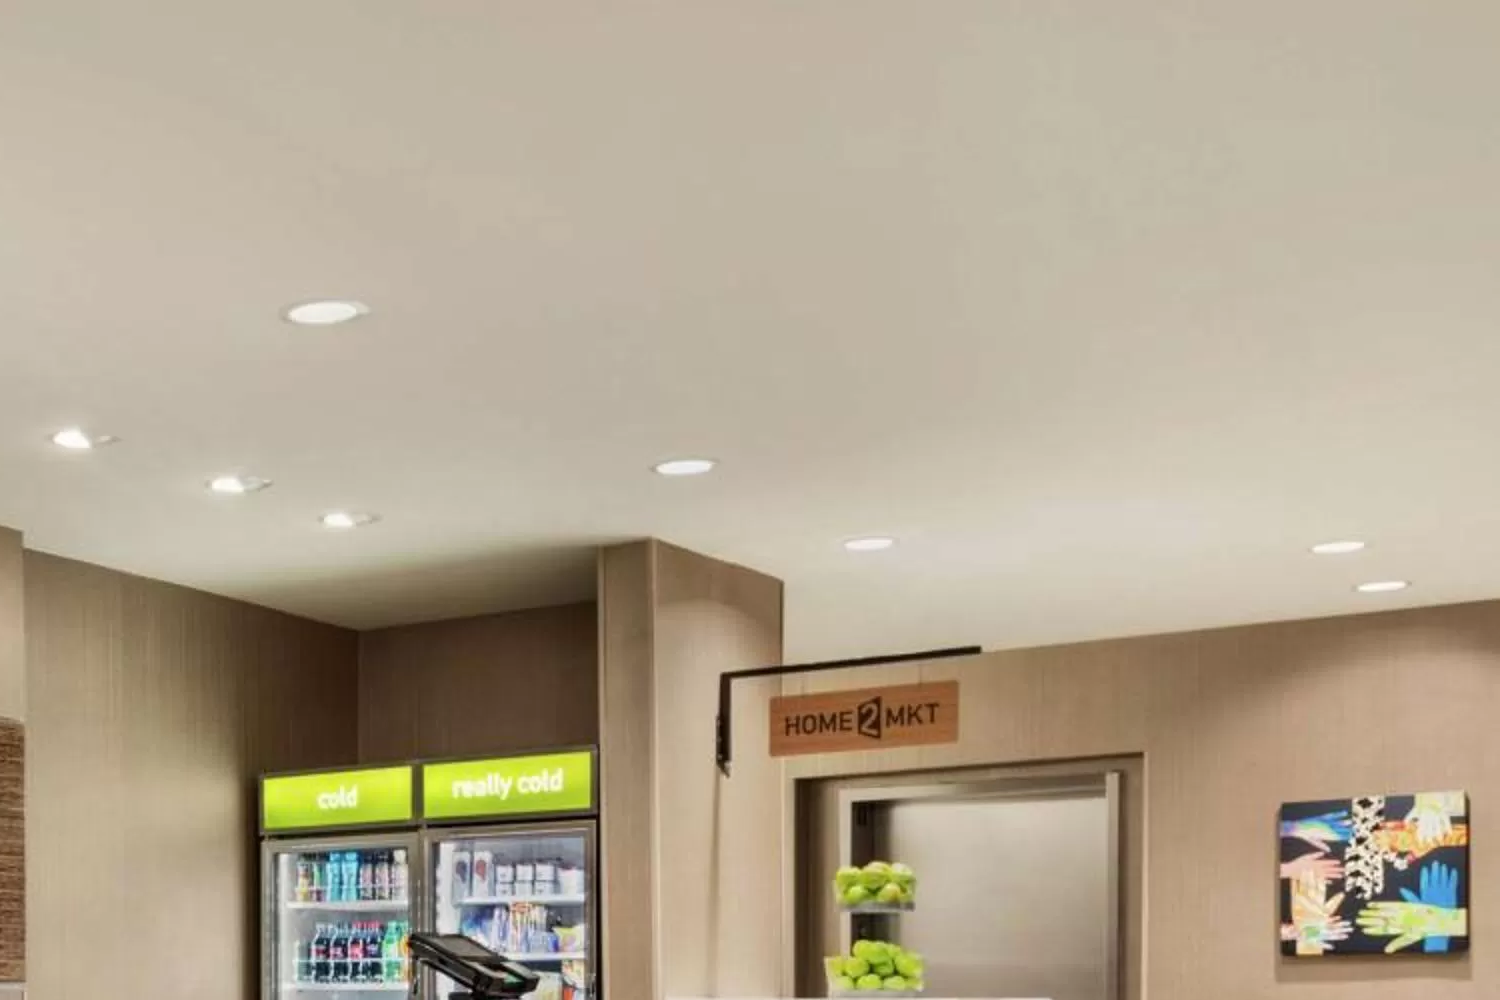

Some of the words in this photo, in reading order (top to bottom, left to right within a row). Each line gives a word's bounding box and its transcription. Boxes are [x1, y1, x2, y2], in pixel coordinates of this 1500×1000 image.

[317, 785, 360, 810] cold
[452, 772, 513, 801] really
[517, 767, 564, 794] cold
